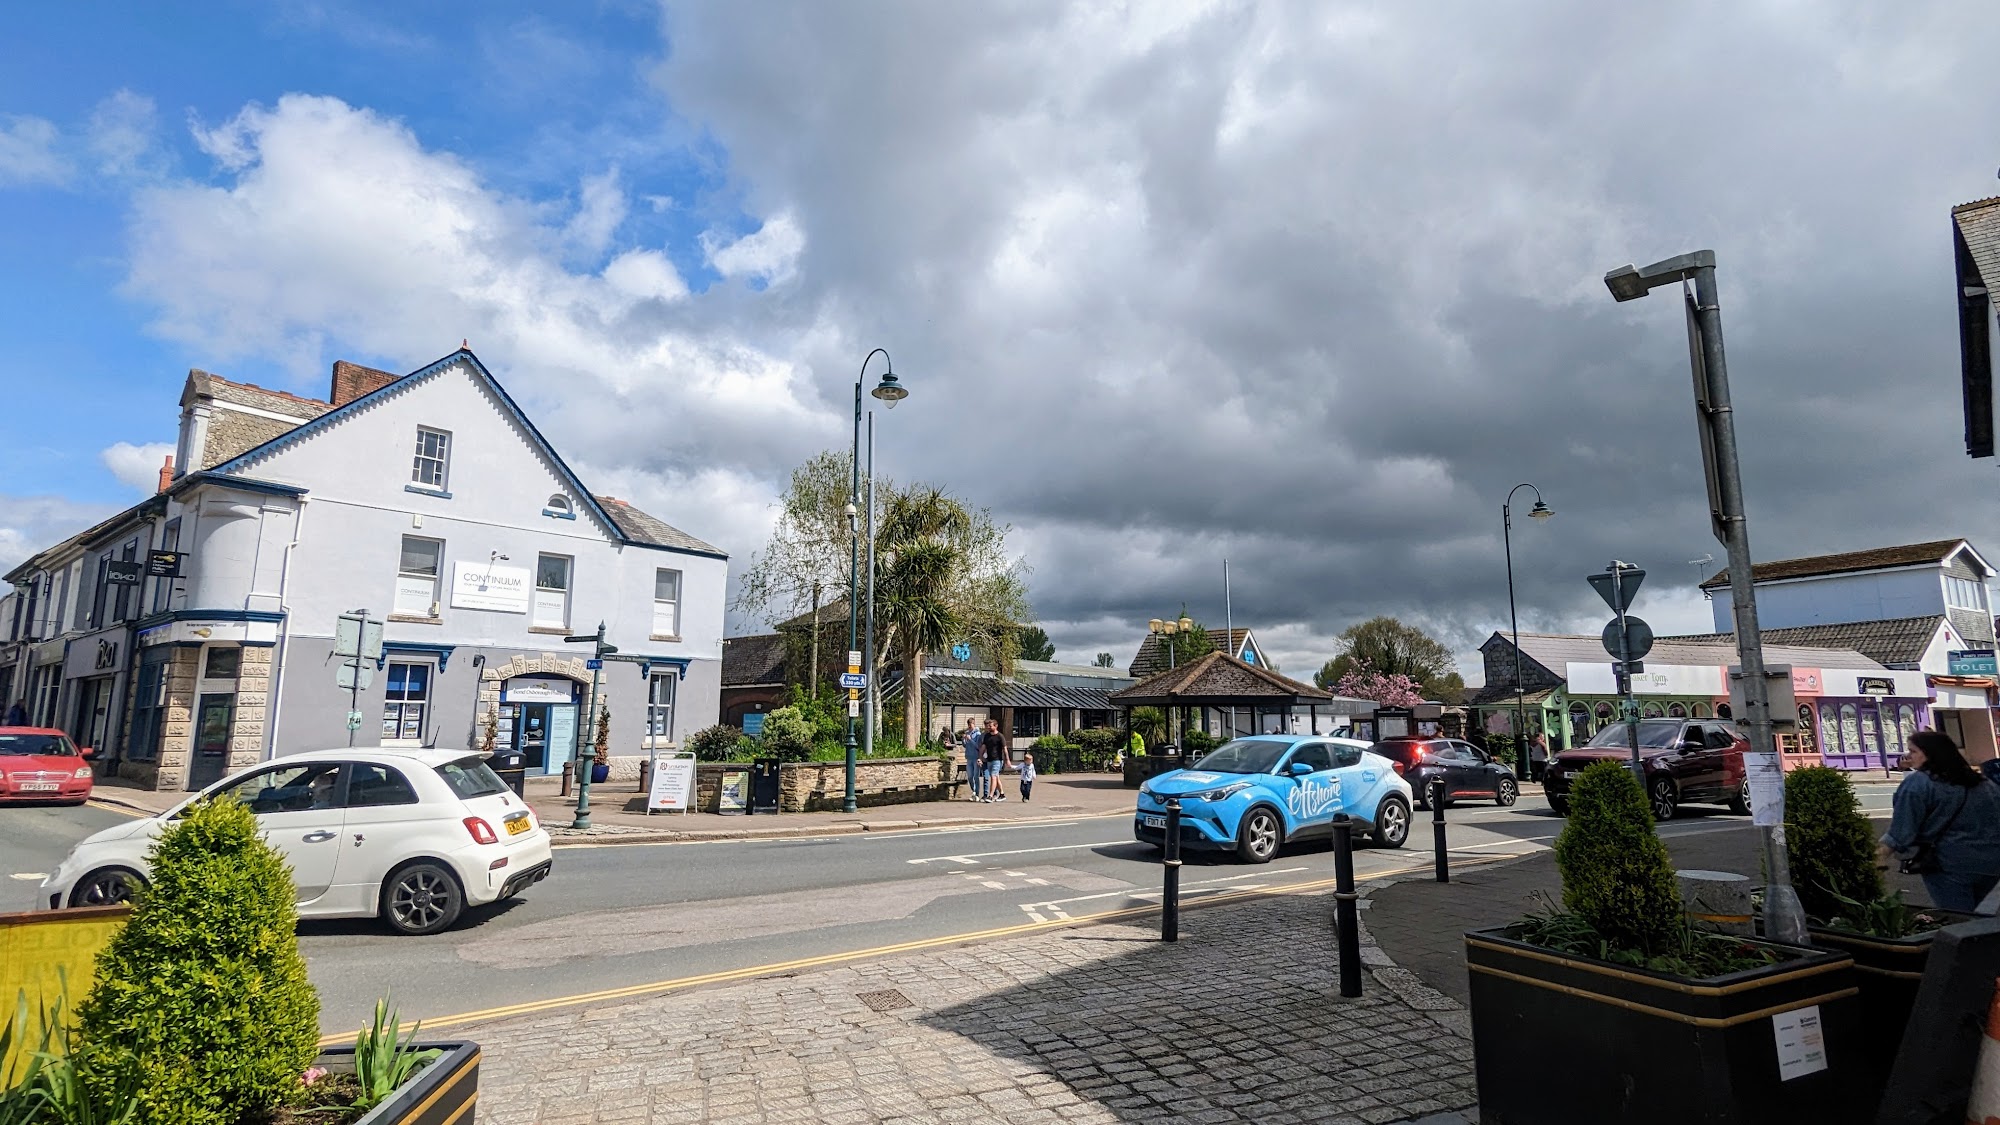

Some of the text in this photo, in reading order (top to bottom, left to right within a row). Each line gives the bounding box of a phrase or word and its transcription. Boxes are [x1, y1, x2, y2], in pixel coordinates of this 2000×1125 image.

[463, 572, 522, 586] CONTINUUM
[1972, 663, 1994, 671] LET
[1287, 778, 1342, 819] Offshore
